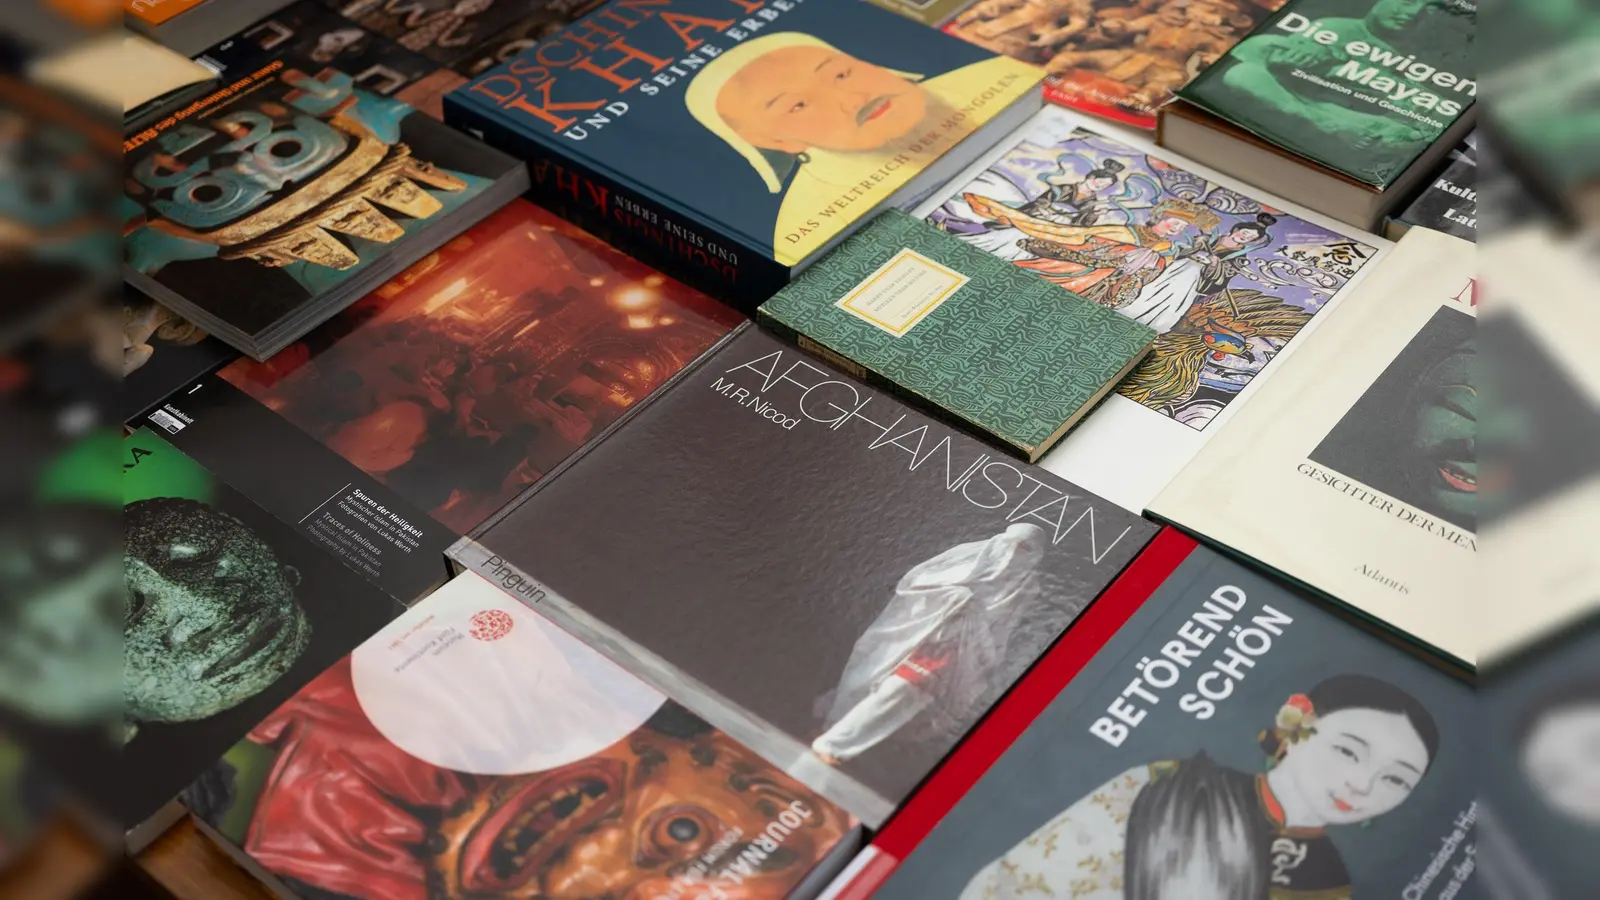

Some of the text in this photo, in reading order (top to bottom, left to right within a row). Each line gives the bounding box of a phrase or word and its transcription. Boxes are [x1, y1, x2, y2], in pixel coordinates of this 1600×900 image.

[1276, 12, 1477, 97] Die ewigen
[564, 101, 629, 141] UND
[640, 43, 723, 96] SEINE
[1291, 68, 1443, 128] Zivilisation und Geschichte
[1336, 60, 1461, 116] Mayas
[785, 219, 820, 245] DAS
[819, 152, 910, 223] WELTREICH
[907, 130, 940, 155] DER
[941, 72, 1019, 132] MONGOLEN
[1434, 178, 1477, 202] Kult
[1443, 207, 1477, 229] Lat
[615, 195, 738, 266] UND SEINE ERBEN
[163, 403, 195, 425] Kunstkabinett
[725, 350, 1132, 565] AFGHANISTAN
[345, 495, 420, 548] Mystischer Islam in Pakistan
[352, 488, 424, 538] Spuren der Heiligkeit
[1297, 463, 1393, 514] GESICHTER
[1396, 507, 1437, 533] DER
[306, 524, 380, 578] Photography by Lukas Werth
[314, 518, 382, 567] Mystical Islam in Pakistan
[322, 511, 382, 556] Traces of Holiness
[337, 500, 412, 554] Fotografien von Lukas Werth
[481, 555, 547, 604] Pinguin
[1353, 563, 1411, 595] Atlantis
[1089, 584, 1248, 747] BETÖREND
[1179, 604, 1295, 720] SCHÖN
[718, 800, 813, 884] JOURNAL
[1402, 829, 1466, 900] Chinesische
